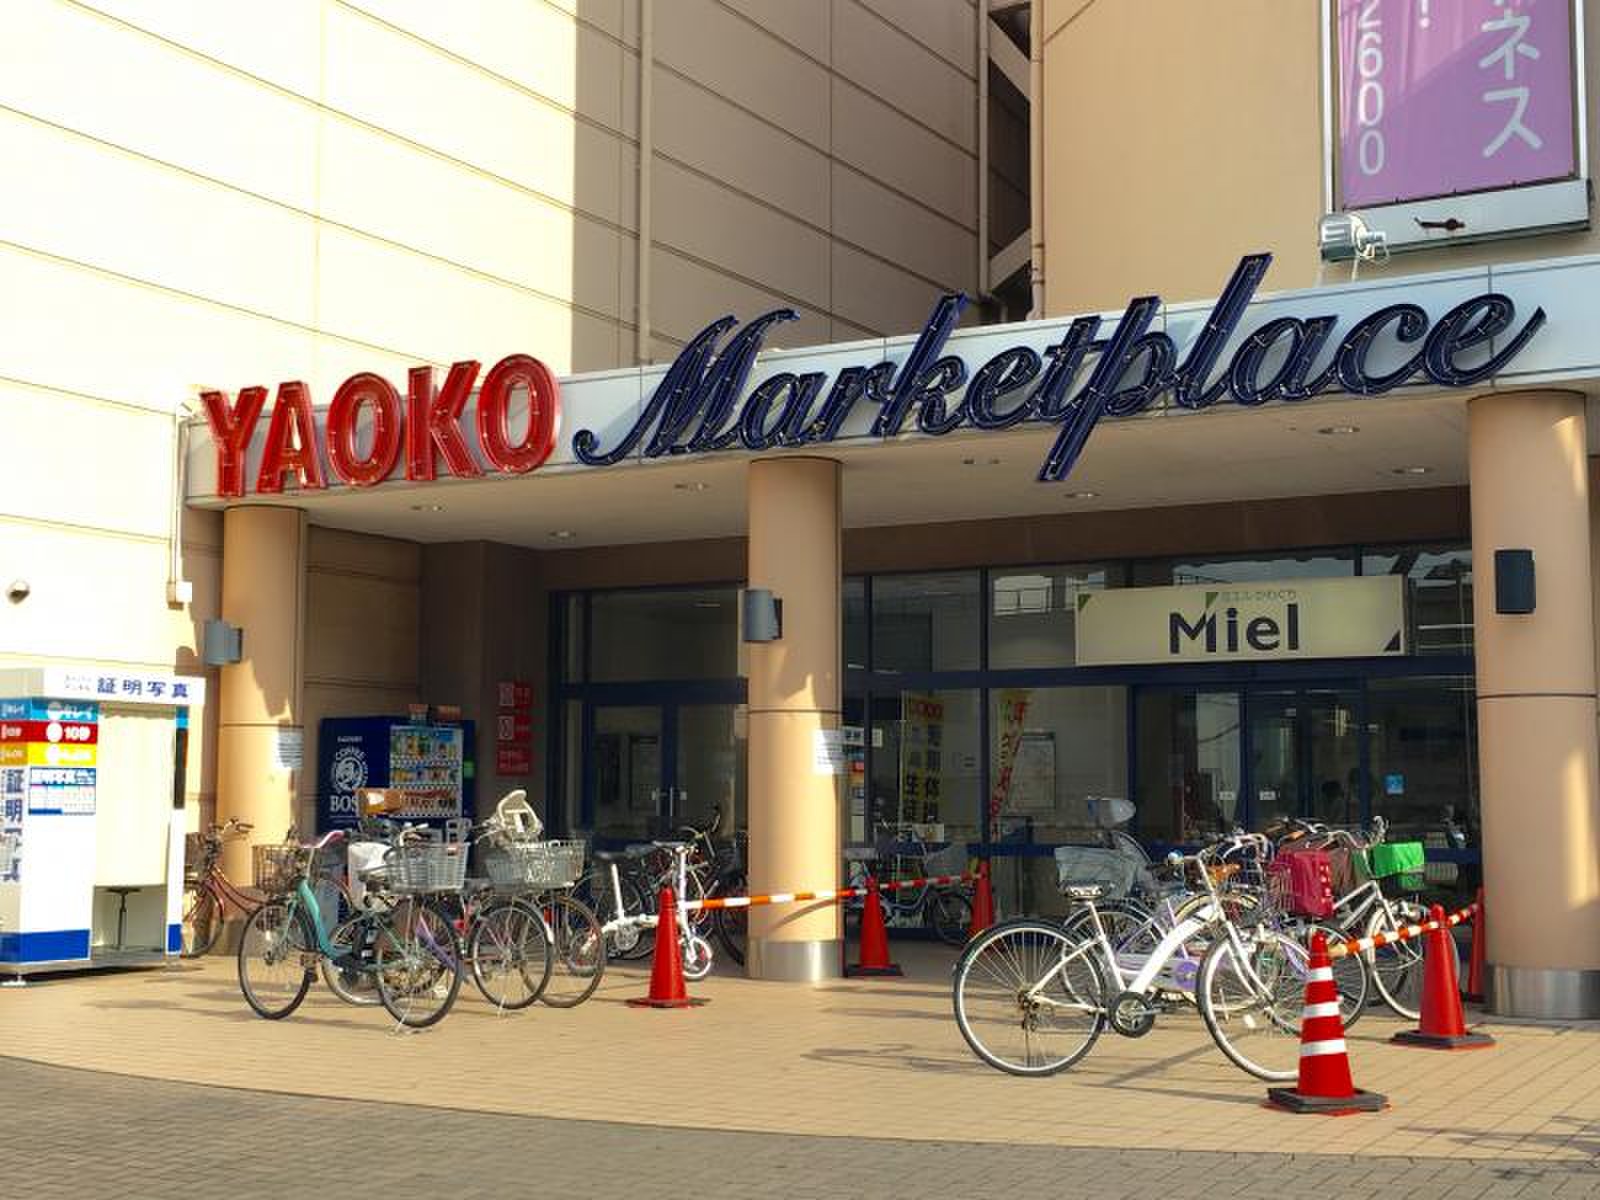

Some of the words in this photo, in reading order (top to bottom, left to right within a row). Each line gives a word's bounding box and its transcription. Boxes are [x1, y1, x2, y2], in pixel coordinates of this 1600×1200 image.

[1478, 0, 1542, 157] ネス
[199, 353, 562, 498] YAOKO
[572, 253, 1547, 482] Marketplace
[1169, 603, 1299, 654] Miel
[97, 677, 189, 698] 証明写真
